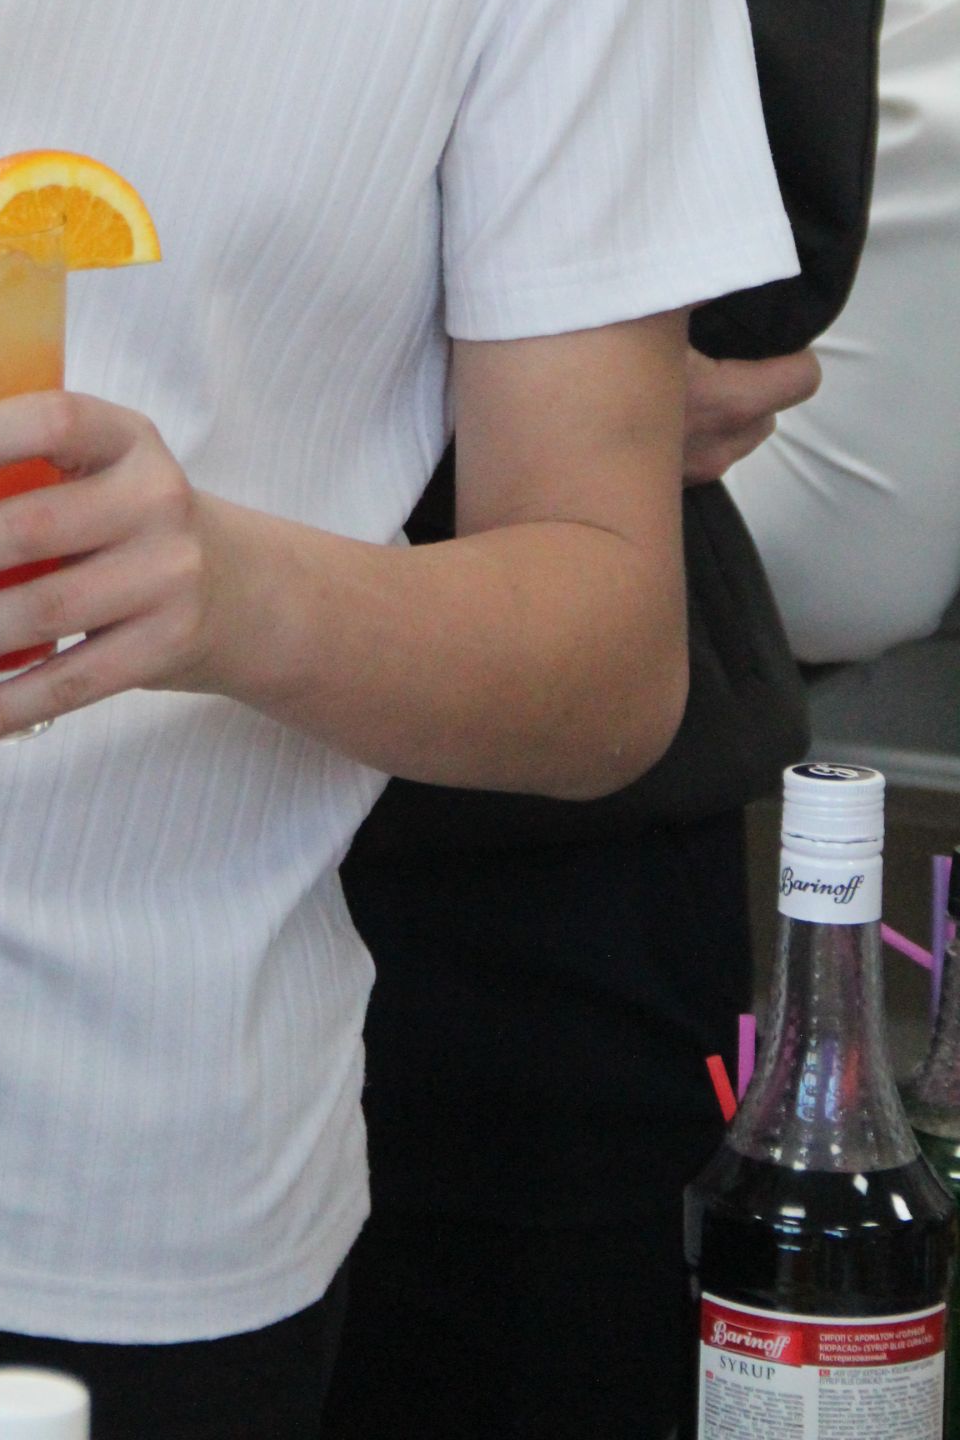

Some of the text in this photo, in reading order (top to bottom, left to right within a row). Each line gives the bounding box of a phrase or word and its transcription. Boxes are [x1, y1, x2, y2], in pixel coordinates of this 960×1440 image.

[780, 867, 864, 904] Barinoff
[711, 1320, 791, 1358] Barinoff
[819, 1333, 846, 1342] СИРОП
[720, 1355, 776, 1380] SYRUP
